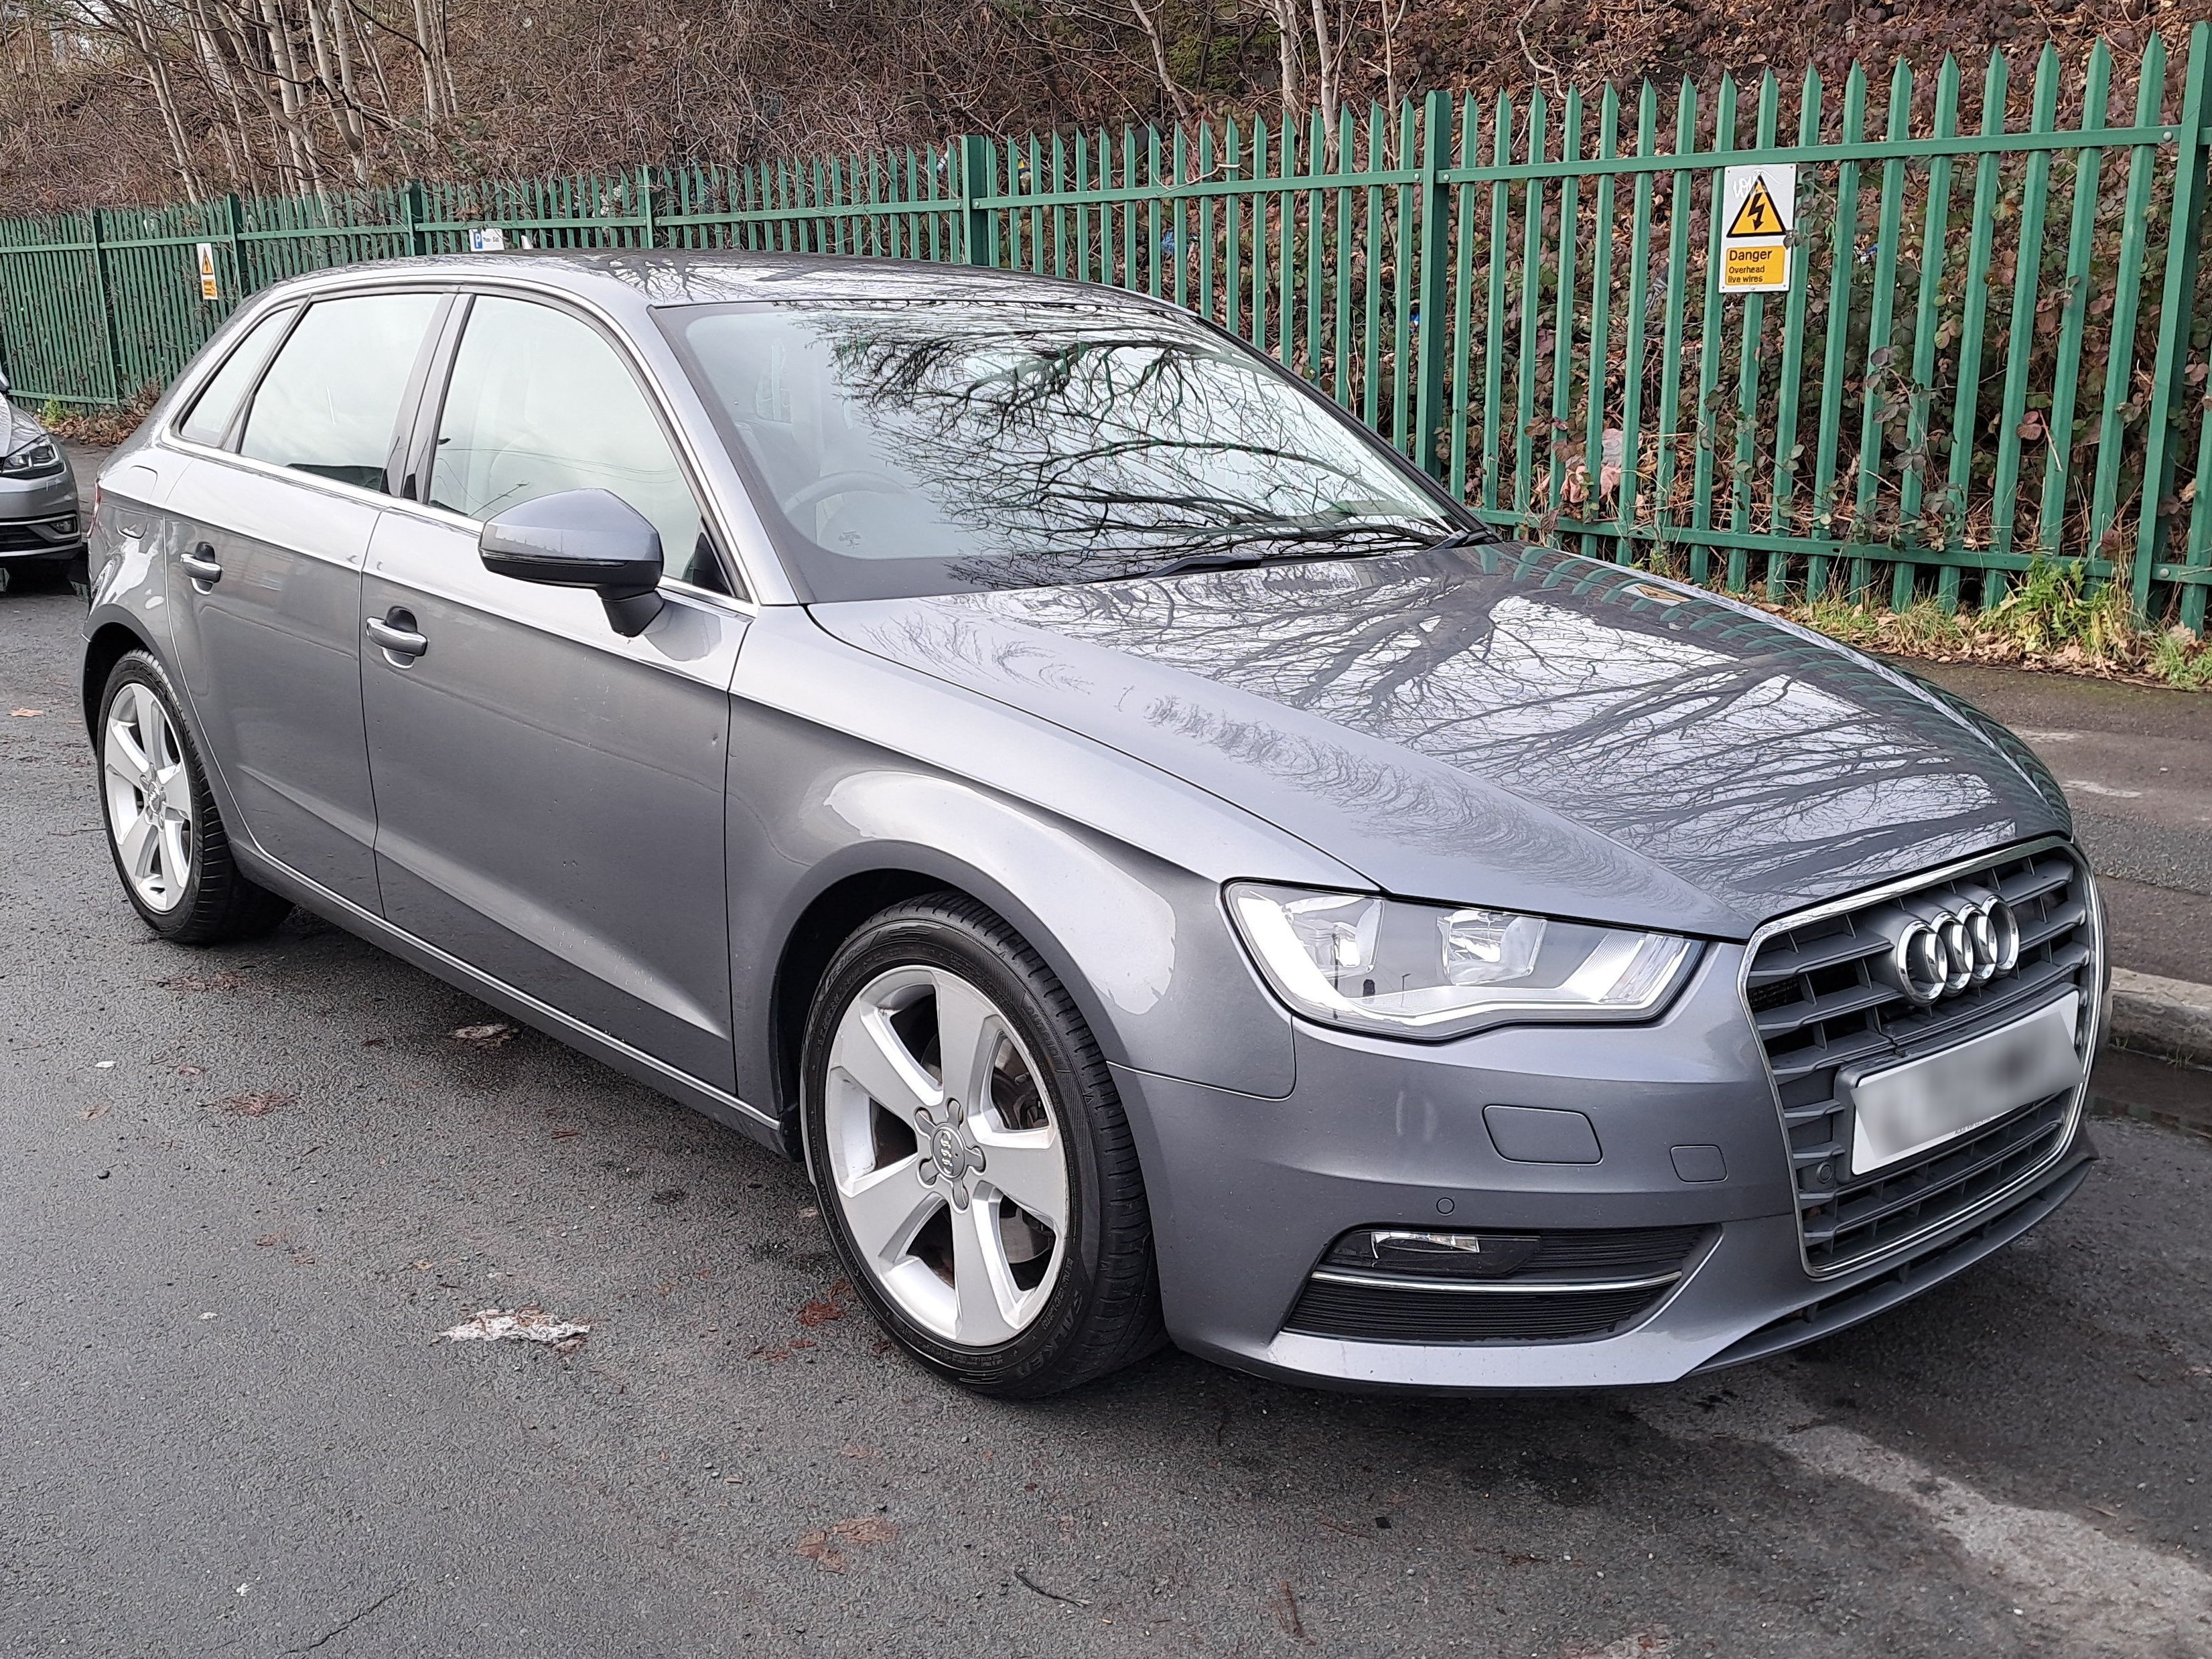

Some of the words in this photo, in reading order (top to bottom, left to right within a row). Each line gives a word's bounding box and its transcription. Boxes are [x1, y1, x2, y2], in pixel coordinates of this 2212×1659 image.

[475, 233, 481, 248] P
[1729, 250, 1773, 261] Danger
[1742, 275, 1763, 283] wires
[1017, 1288, 1083, 1376] FALKEN
